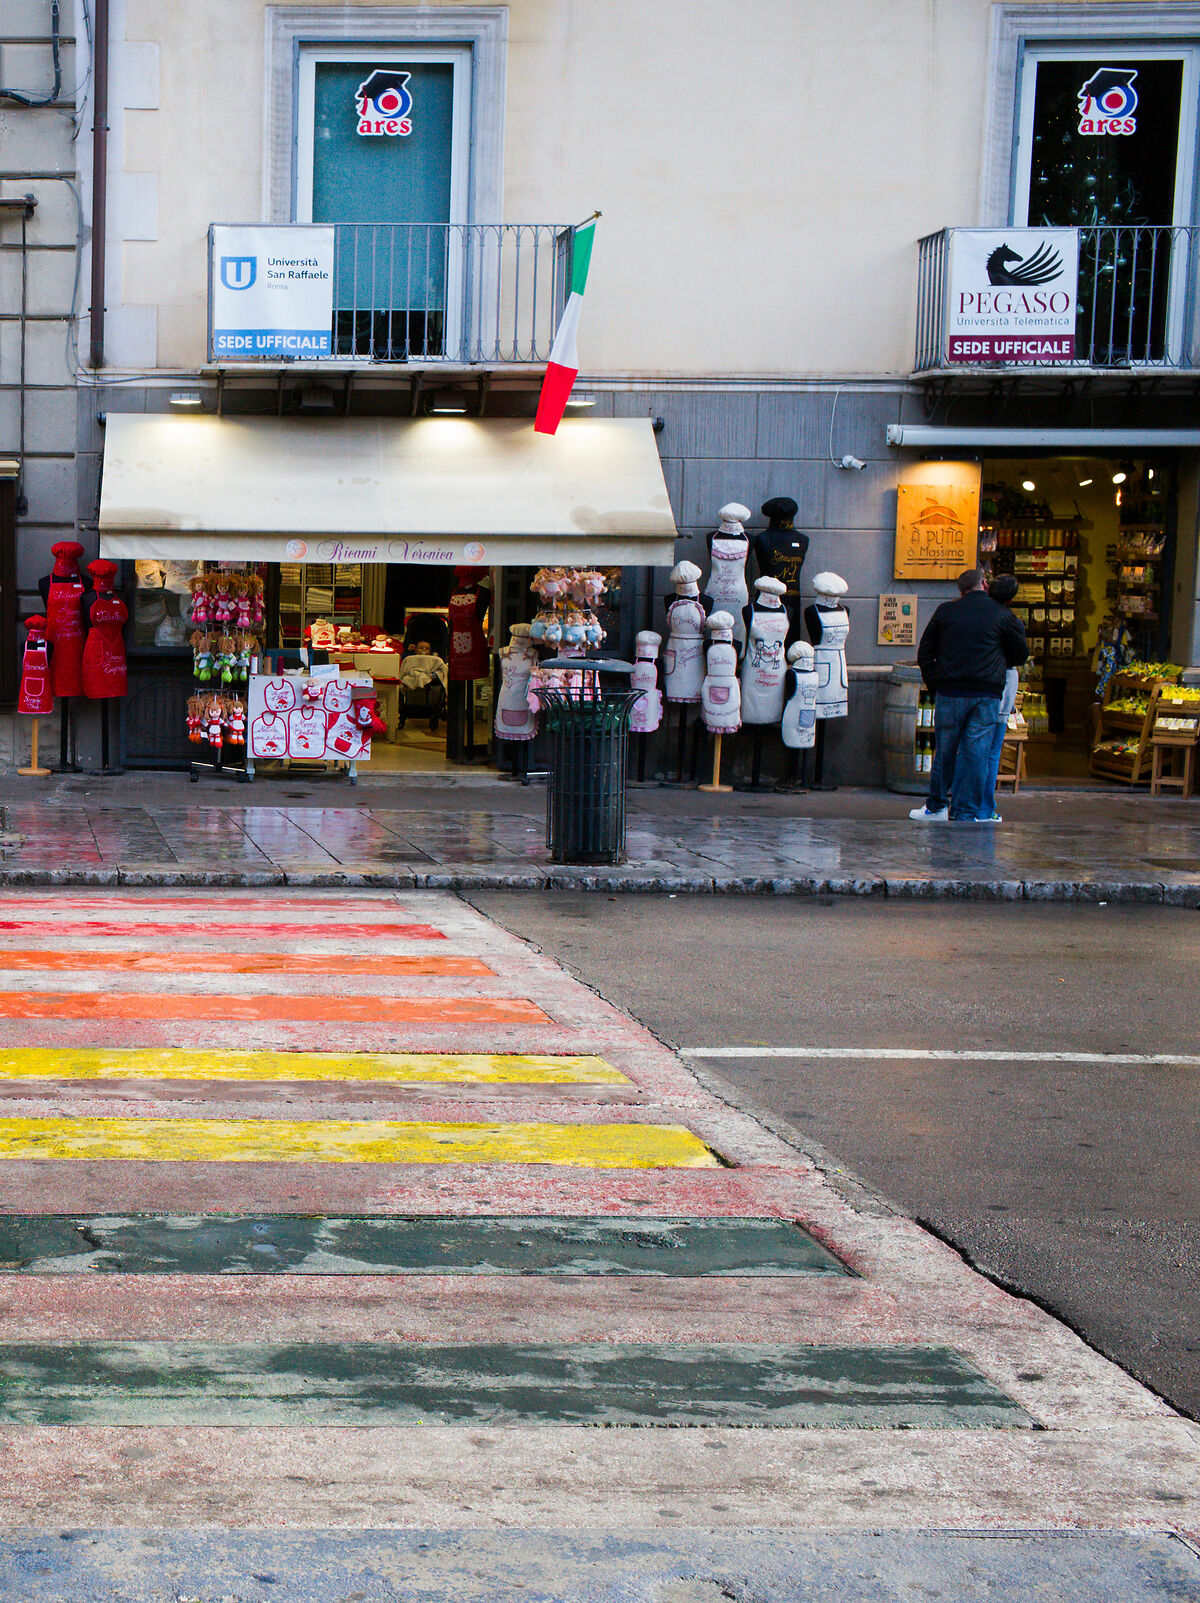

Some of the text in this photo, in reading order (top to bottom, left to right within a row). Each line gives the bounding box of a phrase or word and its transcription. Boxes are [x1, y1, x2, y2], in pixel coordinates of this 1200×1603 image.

[359, 119, 410, 133] ares
[1080, 119, 1134, 133] ares
[267, 258, 319, 267] Università
[267, 270, 329, 279] San Raffaele
[267, 282, 288, 290] Roma
[959, 291, 1070, 314] PEGASO
[956, 317, 1070, 326] Università Telematica
[218, 336, 328, 349] SEDE UFFICIALE
[952, 341, 1070, 354] SEDE UFFICIALE
[316, 539, 378, 561] Ricami
[387, 539, 454, 561] Veronica
[920, 546, 965, 557] Massimo
